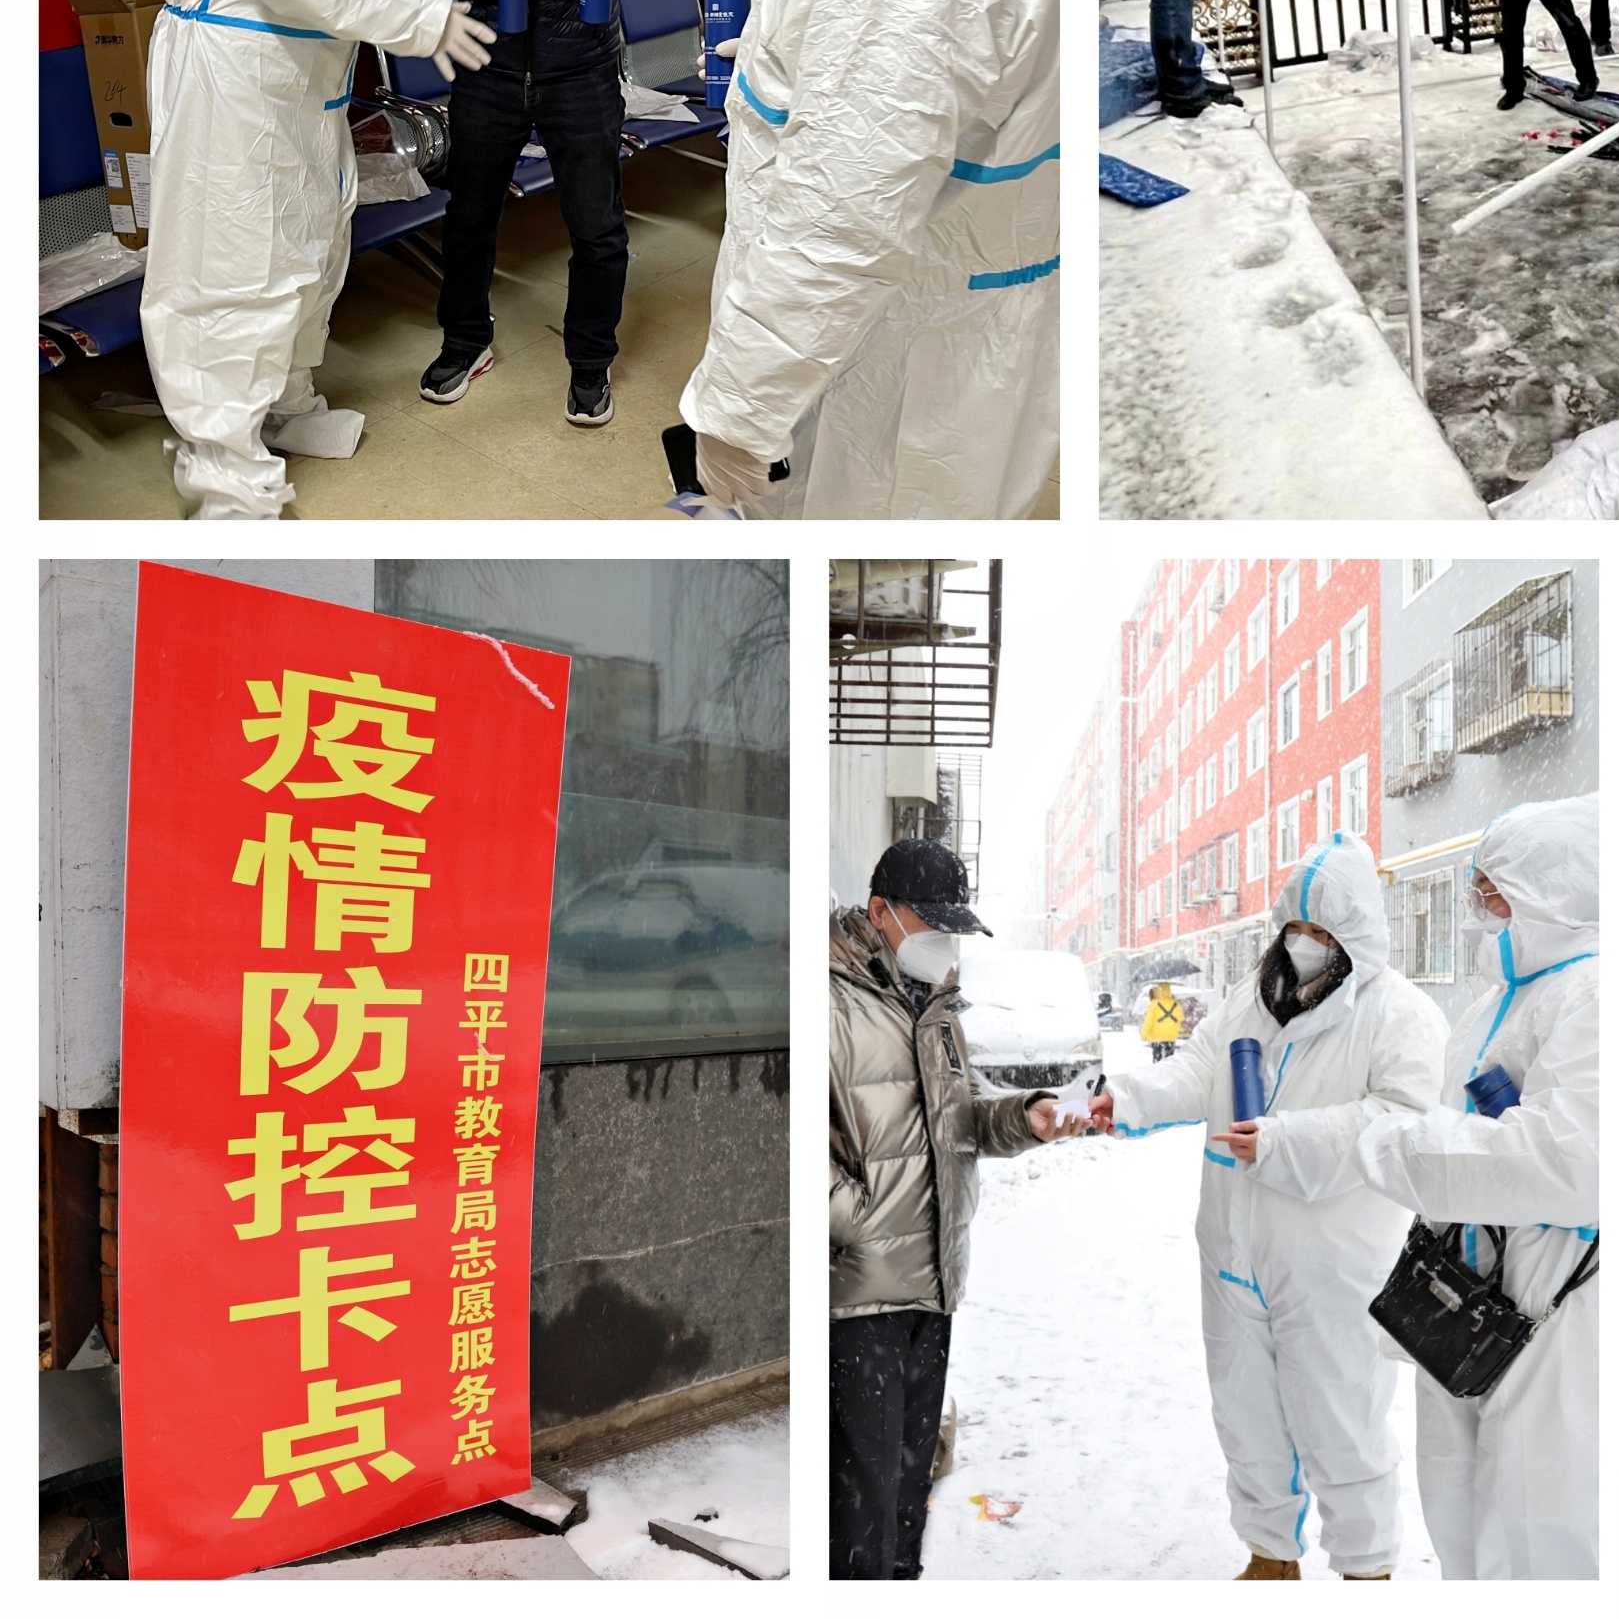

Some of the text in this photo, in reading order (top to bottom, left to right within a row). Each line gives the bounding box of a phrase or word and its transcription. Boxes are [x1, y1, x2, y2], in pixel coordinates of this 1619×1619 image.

[229, 670, 437, 1521] 疫情防控卡点
[448, 951, 510, 1467] 四平市教育局志愿服务点
